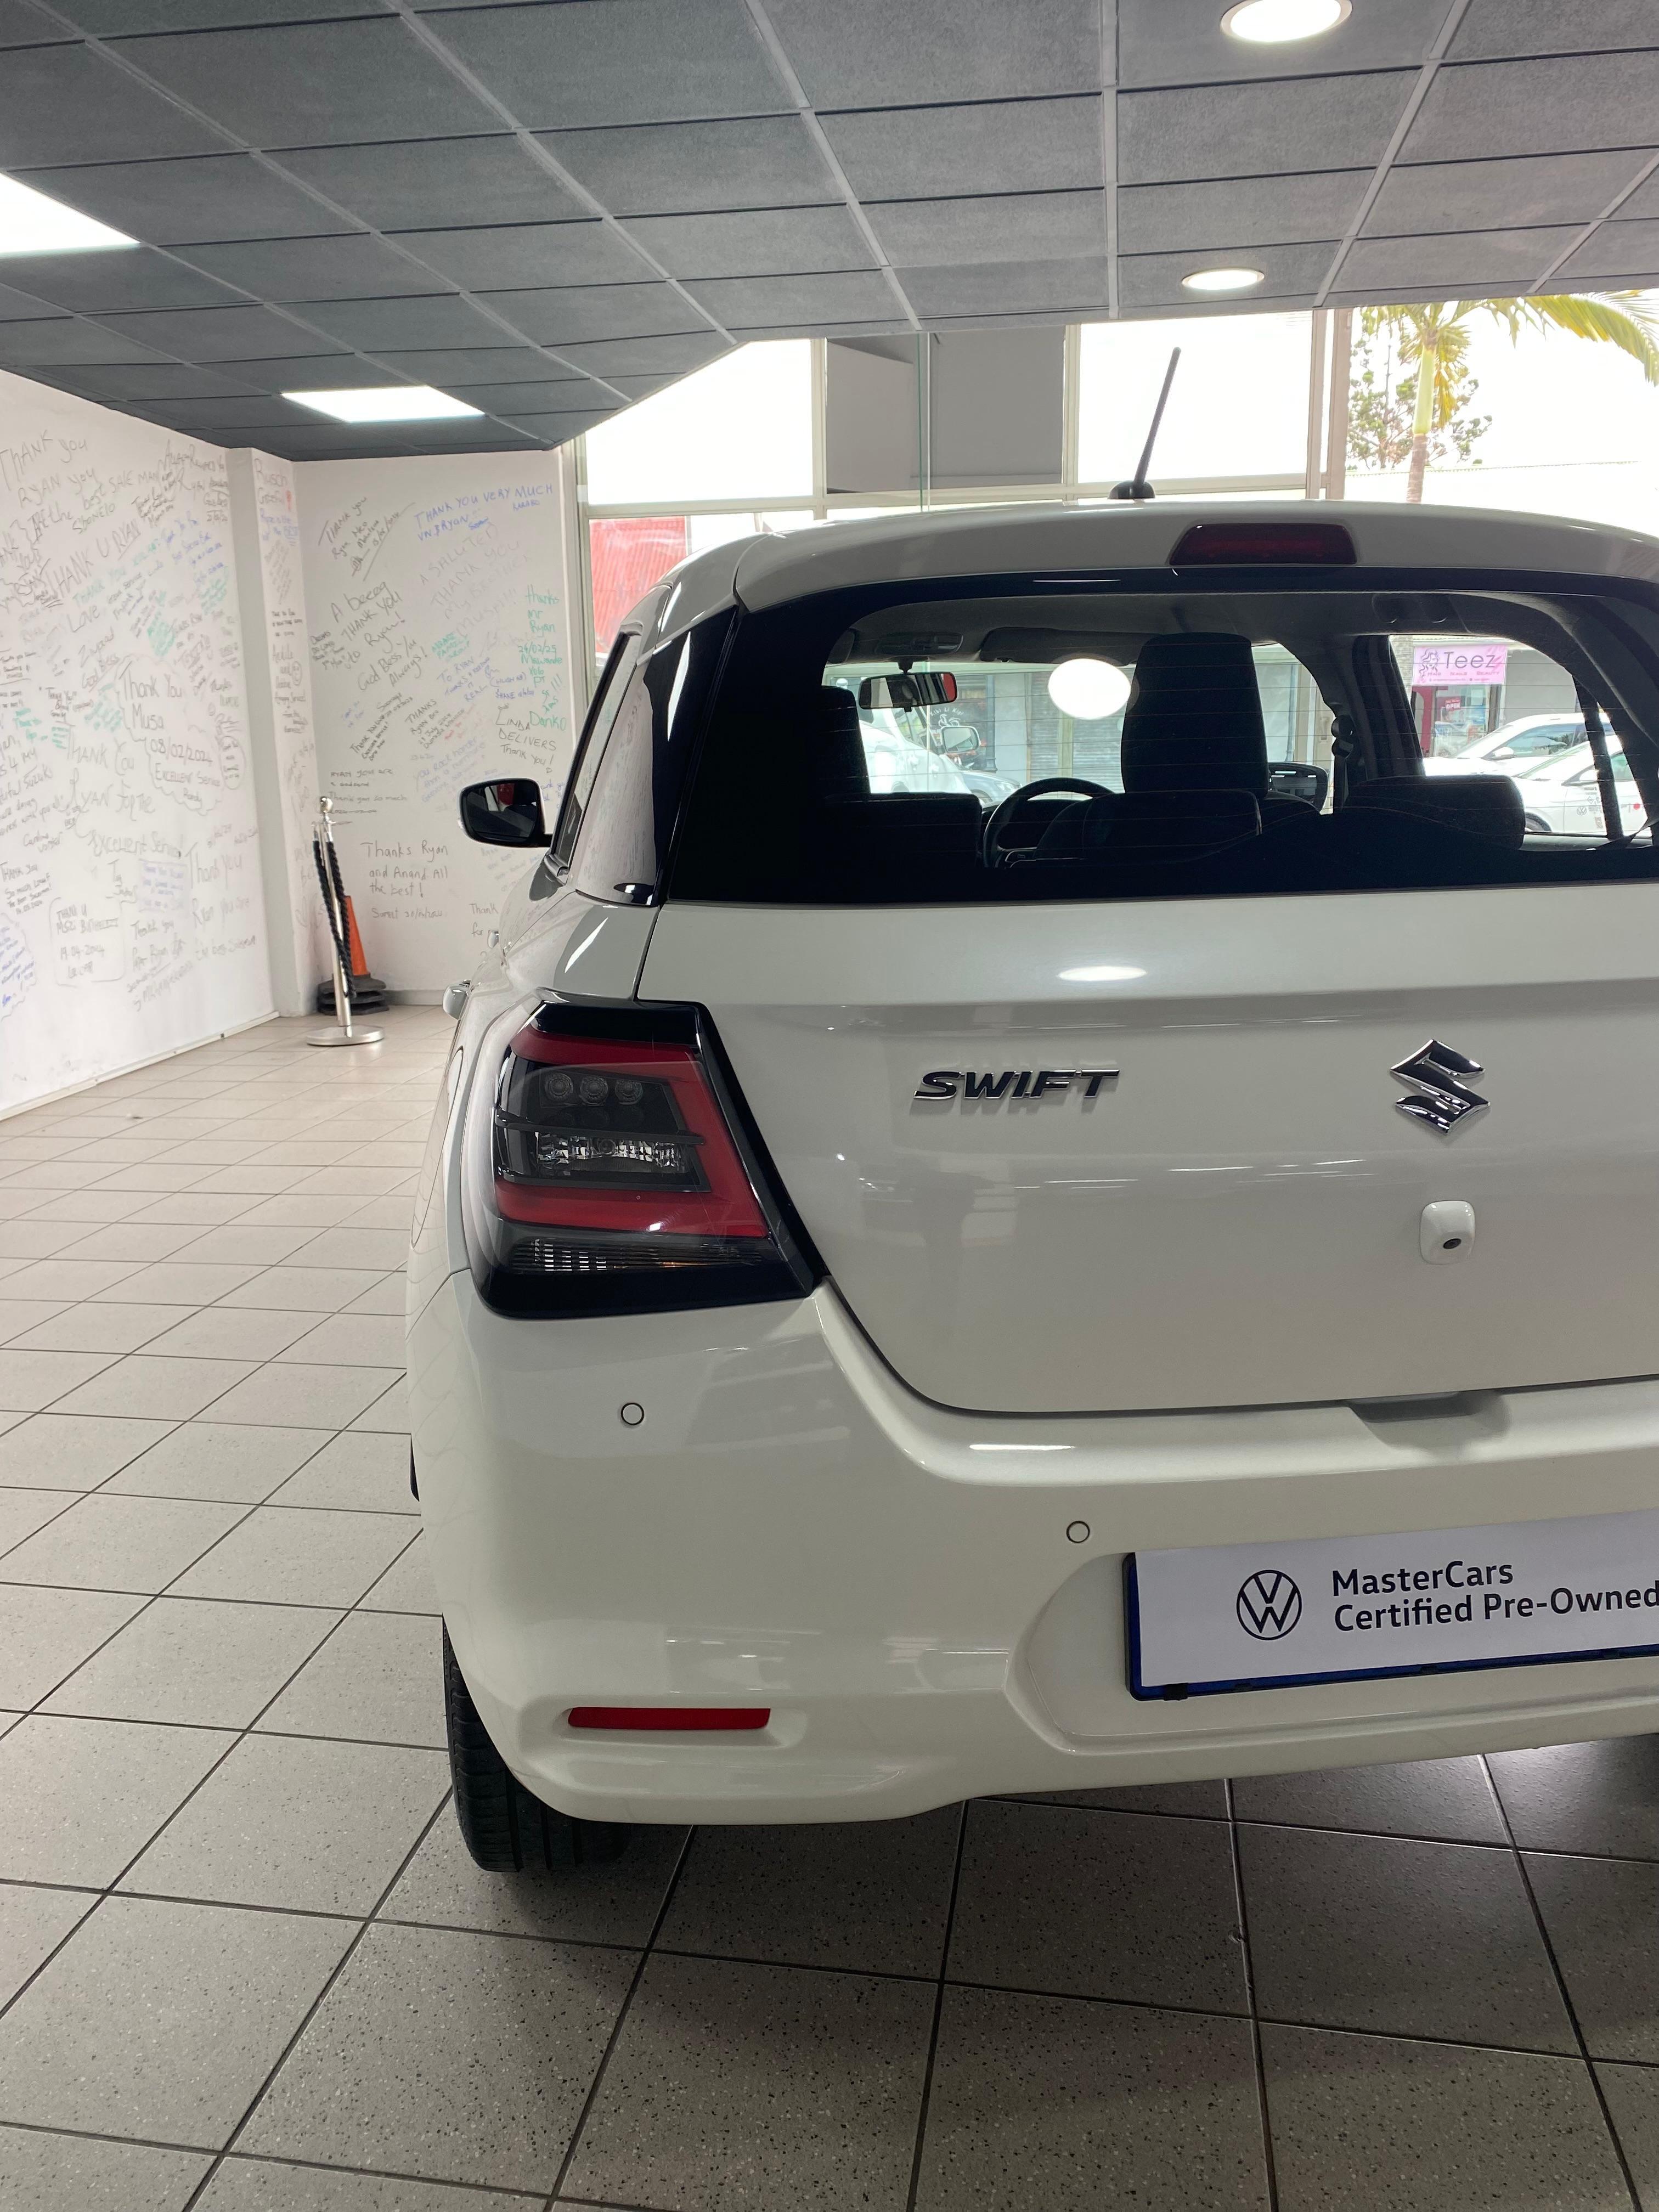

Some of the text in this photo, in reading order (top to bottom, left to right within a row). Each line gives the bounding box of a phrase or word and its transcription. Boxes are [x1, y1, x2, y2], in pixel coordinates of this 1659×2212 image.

[515, 483, 553, 499] MUCH
[1443, 651, 1496, 669] Teez
[498, 728, 557, 752] DELIVERS
[500, 743, 527, 760] Thank
[360, 839, 449, 863] Thanks Ryan
[369, 864, 448, 881] and Anand All
[369, 878, 387, 895] the
[390, 882, 415, 896] best
[469, 902, 499, 915] Thank
[913, 1069, 1120, 1099] SWIFT
[1332, 1560, 1514, 1596] MasterCars
[1333, 1579, 1659, 1632] Certified Pre-Owned
